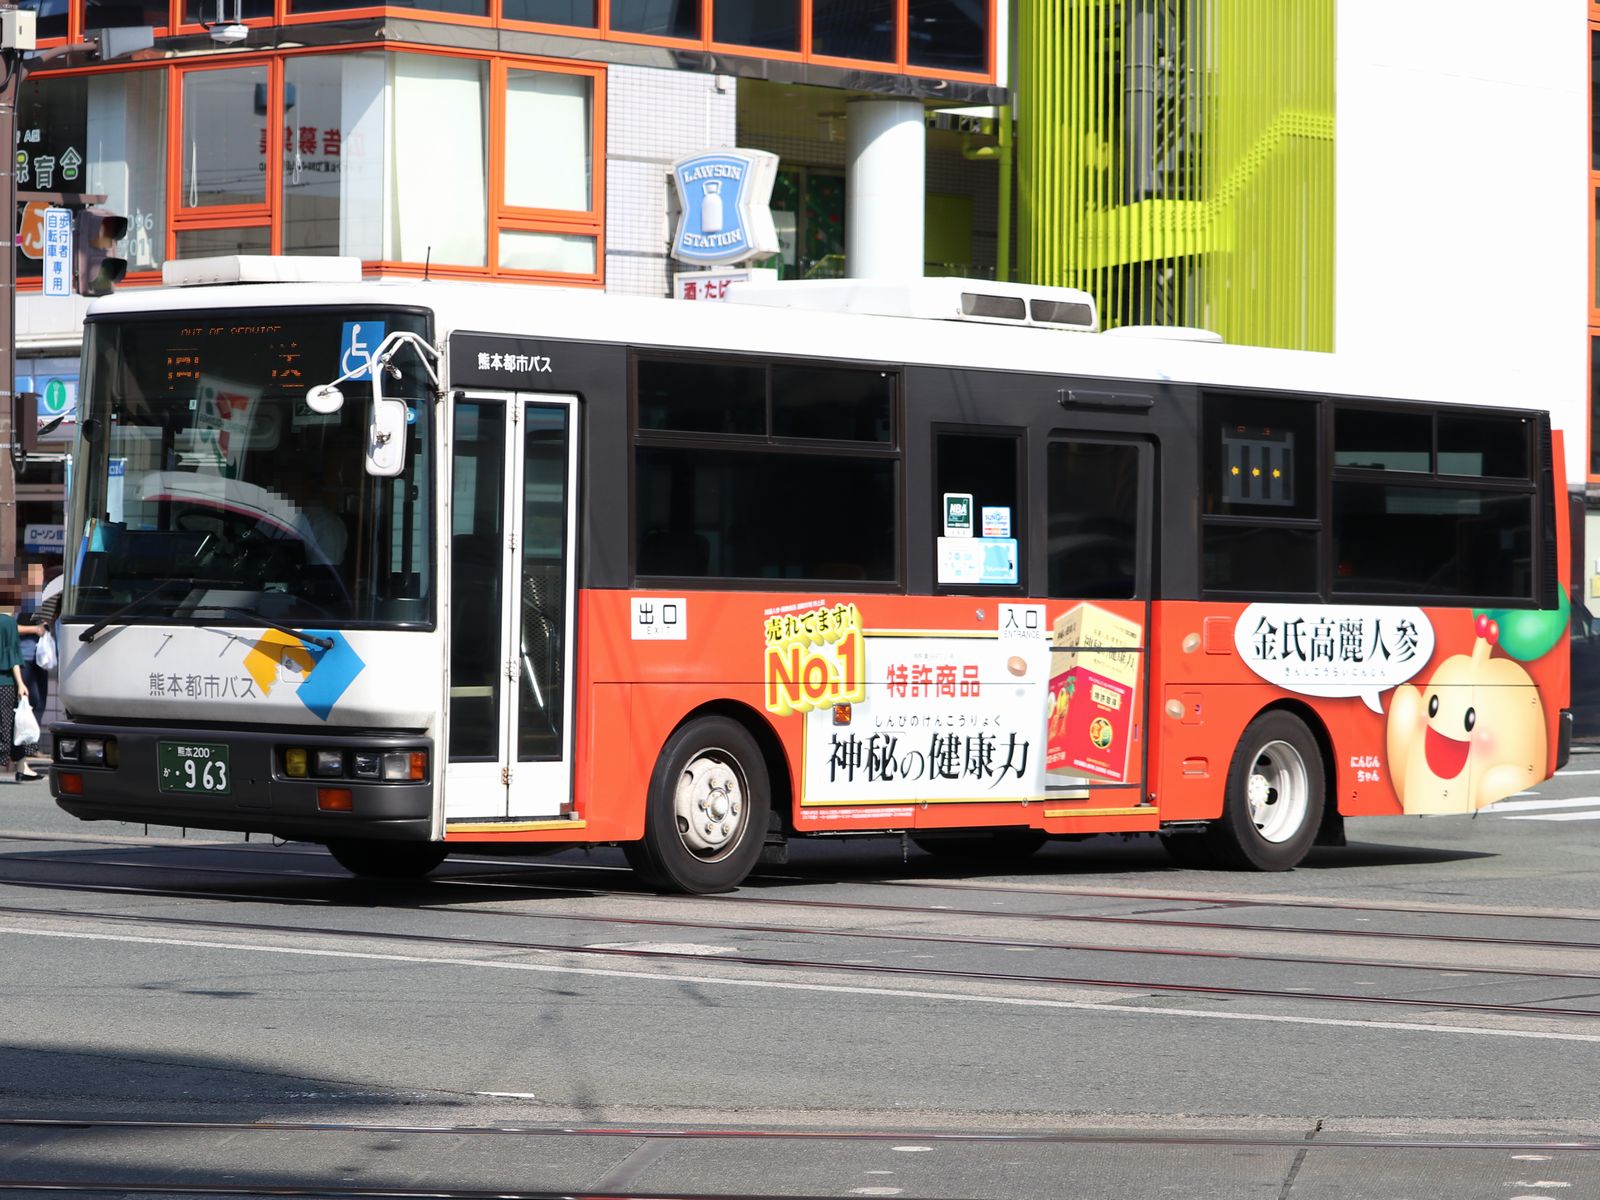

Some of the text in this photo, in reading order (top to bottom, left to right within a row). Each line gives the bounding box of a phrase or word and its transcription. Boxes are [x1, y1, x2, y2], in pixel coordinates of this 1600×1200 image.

[684, 164, 742, 184] LAWSON
[48, 215, 58, 257] 自転車
[59, 215, 69, 258] 歩行者
[683, 228, 742, 248] STATION
[53, 261, 62, 291] 専用
[477, 352, 552, 373] 熊本都市バス
[639, 602, 677, 625] 出口
[1005, 608, 1037, 629] 入口
[647, 626, 671, 635] EXIT
[1004, 630, 1040, 639] ENTRANCE
[1251, 615, 1419, 663] 金氏高麗人参
[769, 632, 856, 706] No.1
[886, 664, 981, 698] 特許商品
[149, 672, 257, 699] 熊本都市バス
[177, 746, 210, 758] 熊本200
[826, 730, 1030, 790] 神秘の健康力
